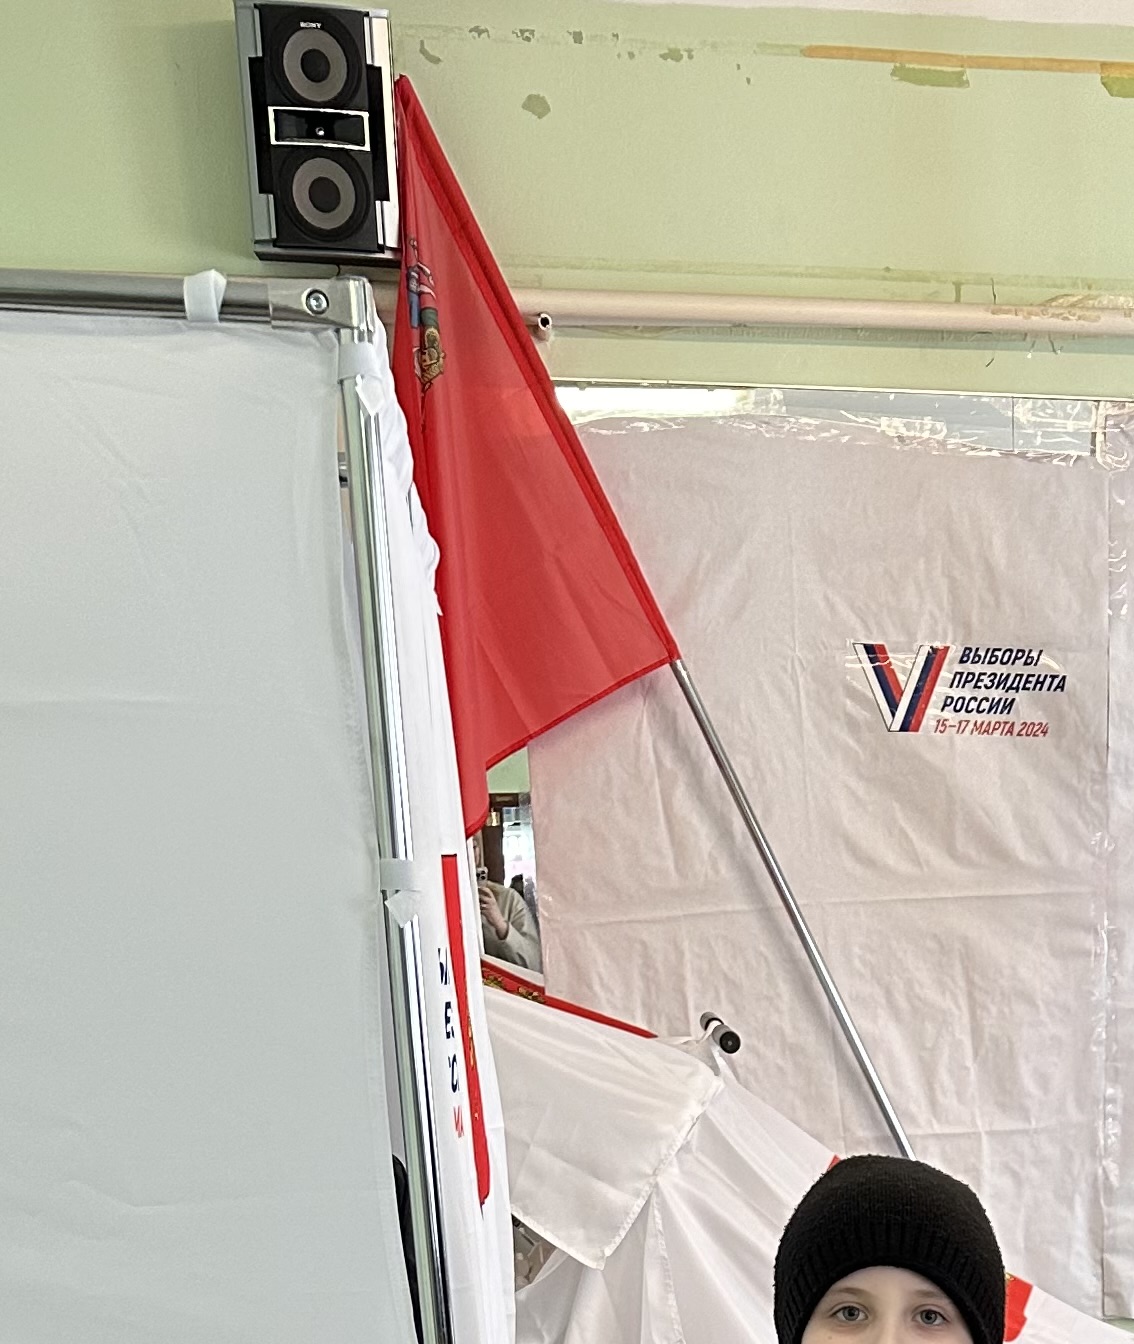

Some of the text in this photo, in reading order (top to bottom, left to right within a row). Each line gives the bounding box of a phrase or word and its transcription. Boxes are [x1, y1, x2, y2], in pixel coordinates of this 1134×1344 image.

[958, 646, 1044, 667] ВЫБОРЫ
[949, 671, 1067, 693] ПРЕЗИДЕНТА
[940, 695, 1016, 715] РОССИИ
[970, 720, 1013, 736] МАРТА
[1016, 721, 1049, 737] 2024
